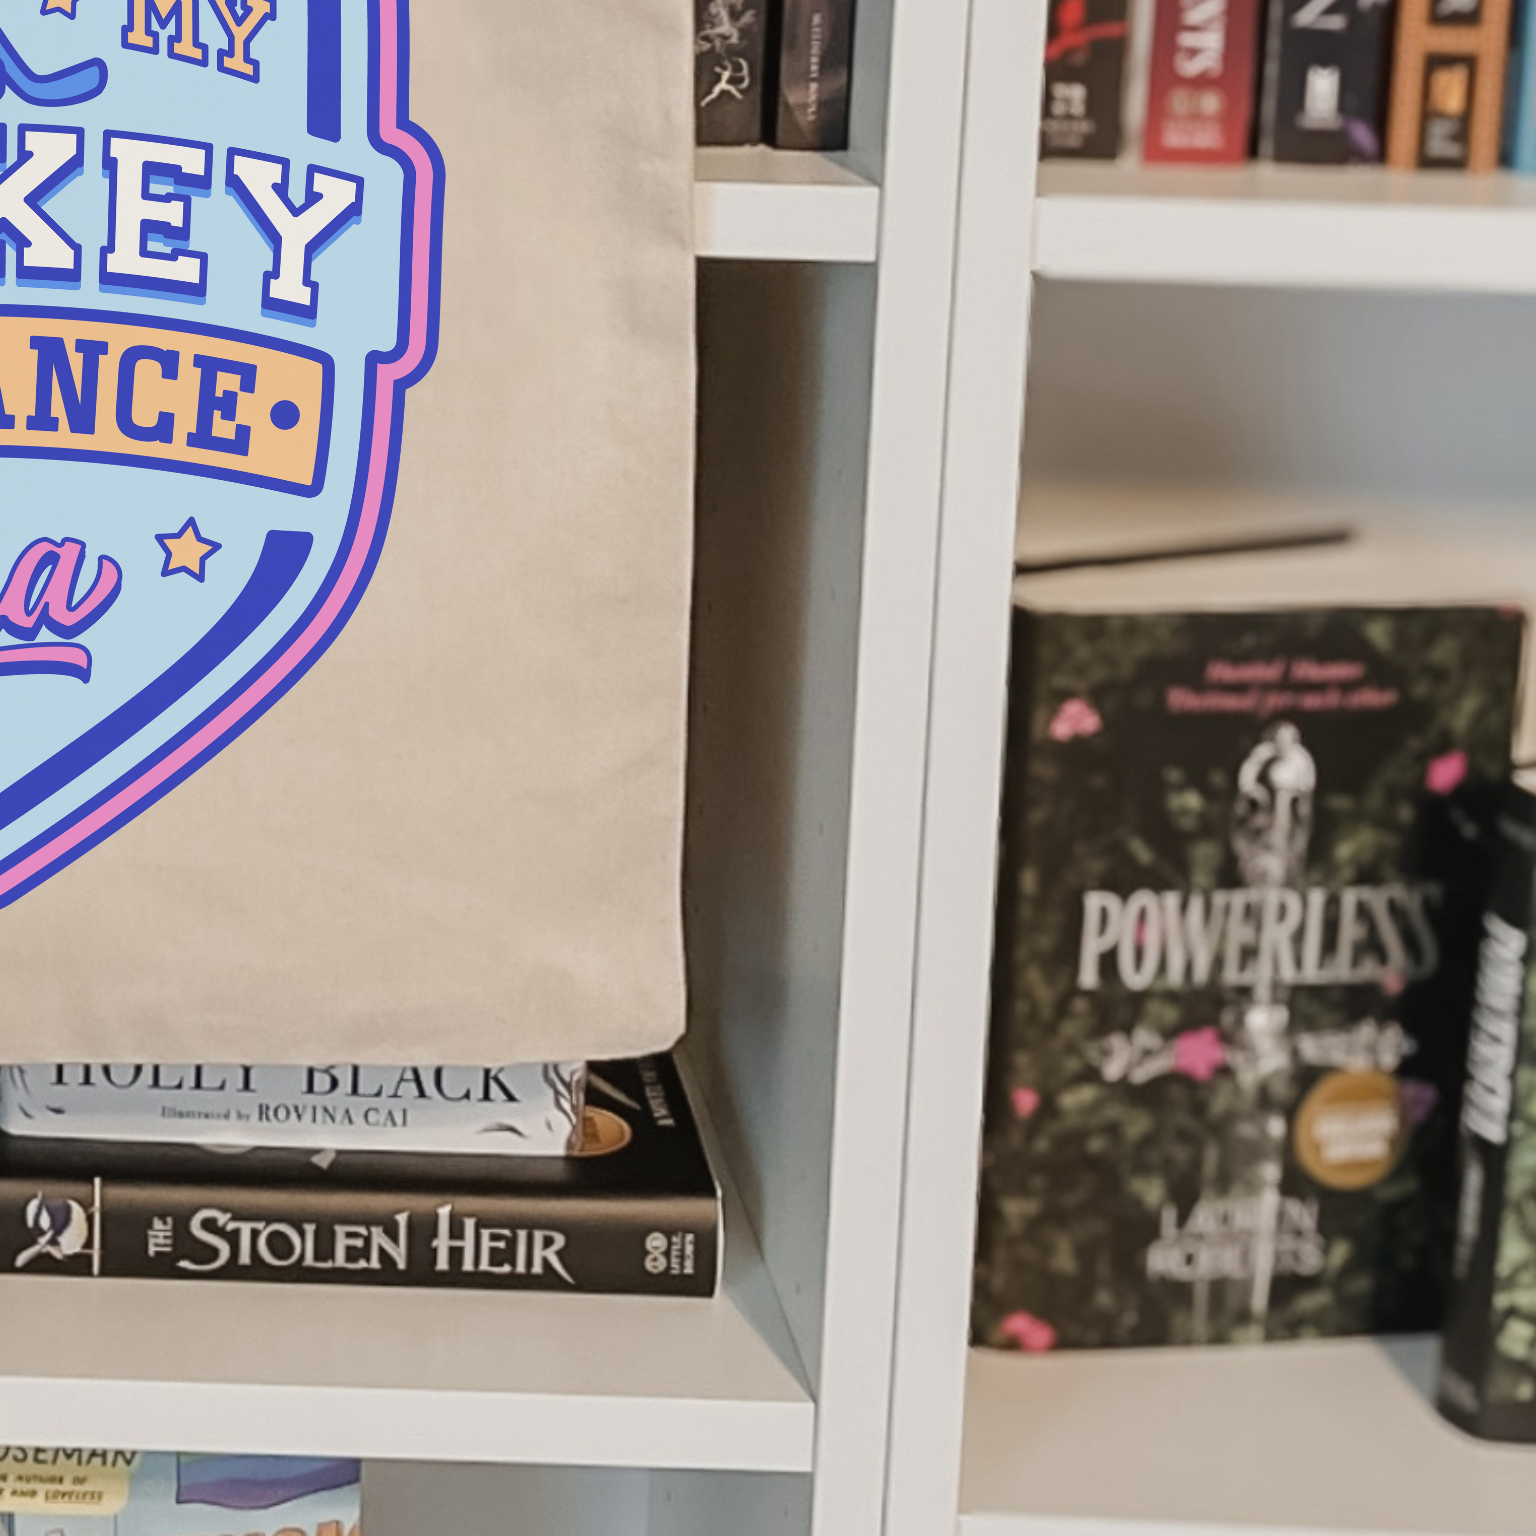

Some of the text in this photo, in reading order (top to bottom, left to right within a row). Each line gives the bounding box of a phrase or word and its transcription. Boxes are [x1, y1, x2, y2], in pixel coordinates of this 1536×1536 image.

[1077, 884, 1442, 990] POWERLESS
[257, 1103, 355, 1126] ROVINA
[364, 1108, 408, 1128] CAI
[148, 1216, 173, 1258] THE
[176, 1209, 411, 1272] STOLEN
[432, 1204, 575, 1285] HEIR
[16, 1474, 63, 1485] AUTHOR
